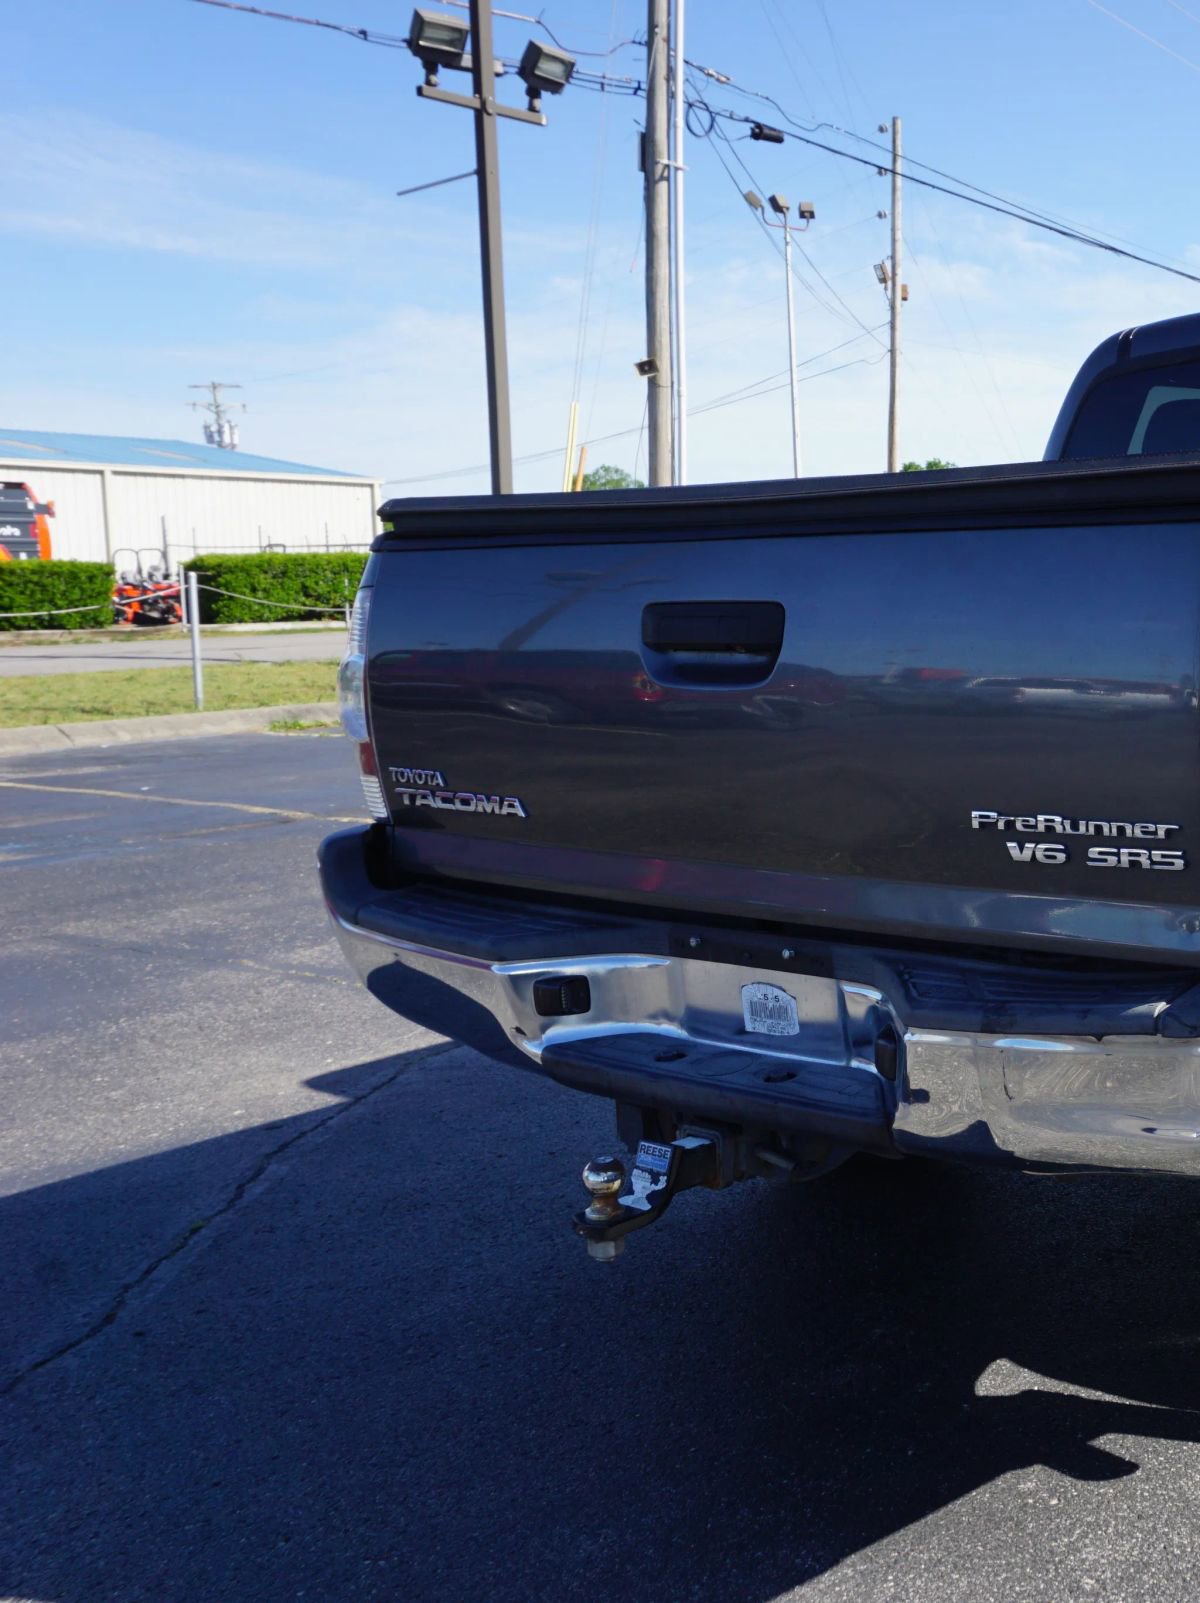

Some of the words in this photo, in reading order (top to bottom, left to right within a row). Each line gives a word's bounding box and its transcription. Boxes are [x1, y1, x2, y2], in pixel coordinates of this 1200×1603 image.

[389, 767, 446, 787] TOYOTA
[395, 787, 527, 818] TACOMA
[971, 810, 1179, 839] PreRunner
[1006, 841, 1067, 864] V6
[1086, 847, 1185, 871] SR5
[639, 1143, 670, 1160] REESE
